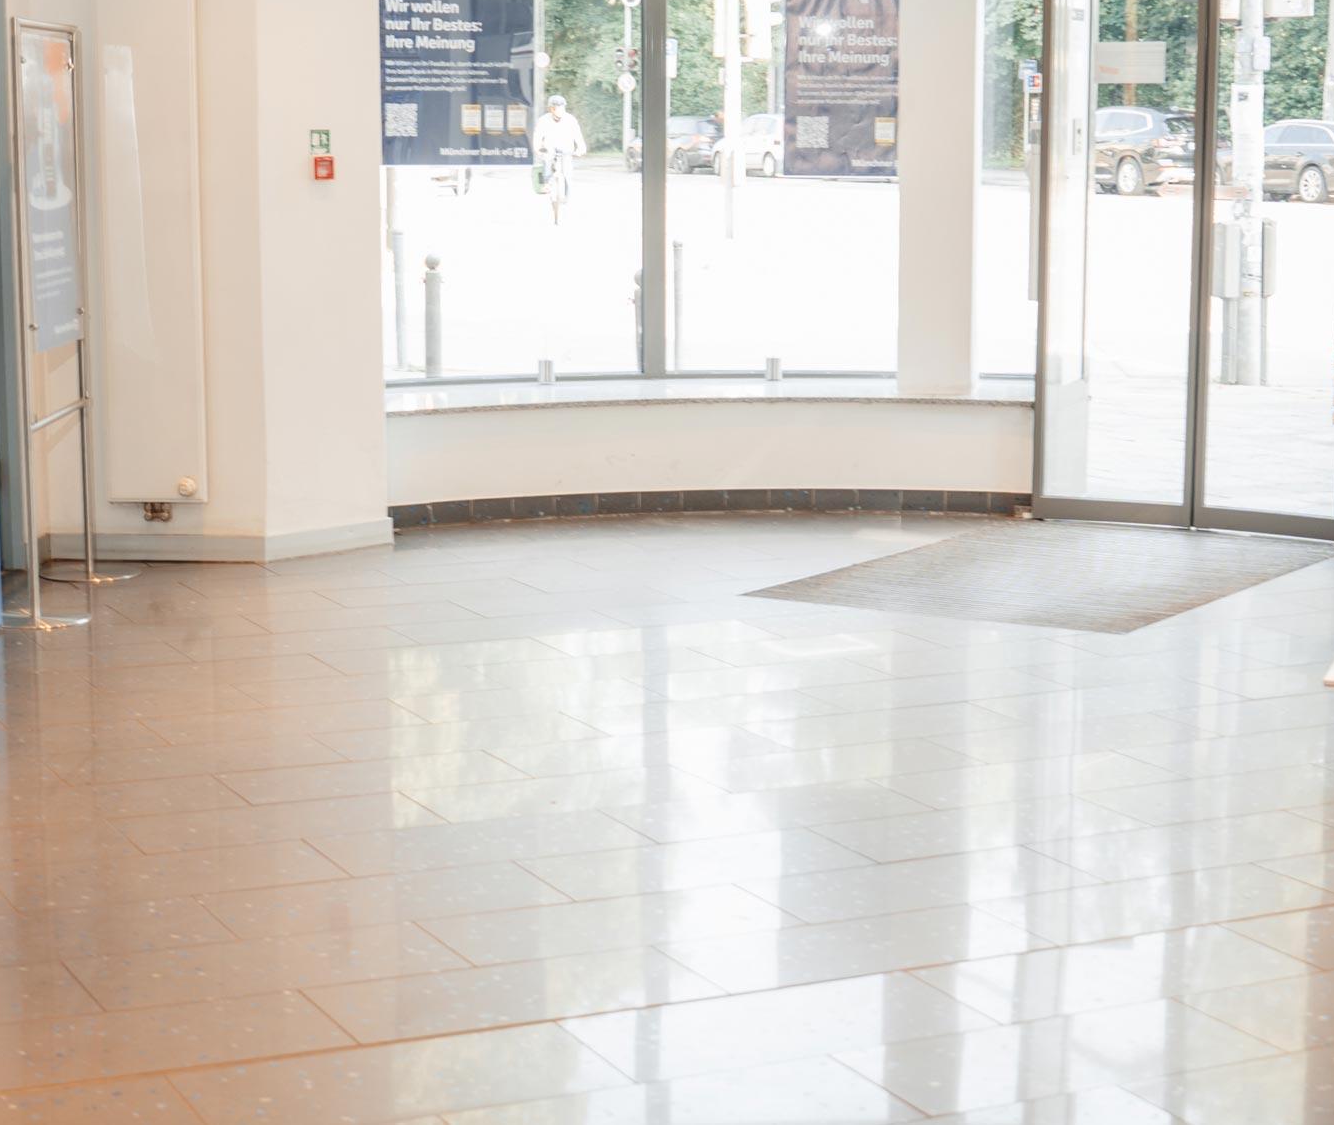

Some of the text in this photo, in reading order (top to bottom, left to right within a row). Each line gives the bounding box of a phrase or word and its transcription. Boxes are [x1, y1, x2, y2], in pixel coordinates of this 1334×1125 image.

[385, 0, 460, 14] Wir wollen
[384, 17, 483, 32] nur Ihr Bestes:
[385, 35, 475, 52] Ihre Meinung
[799, 50, 890, 67] Ihre Meinung
